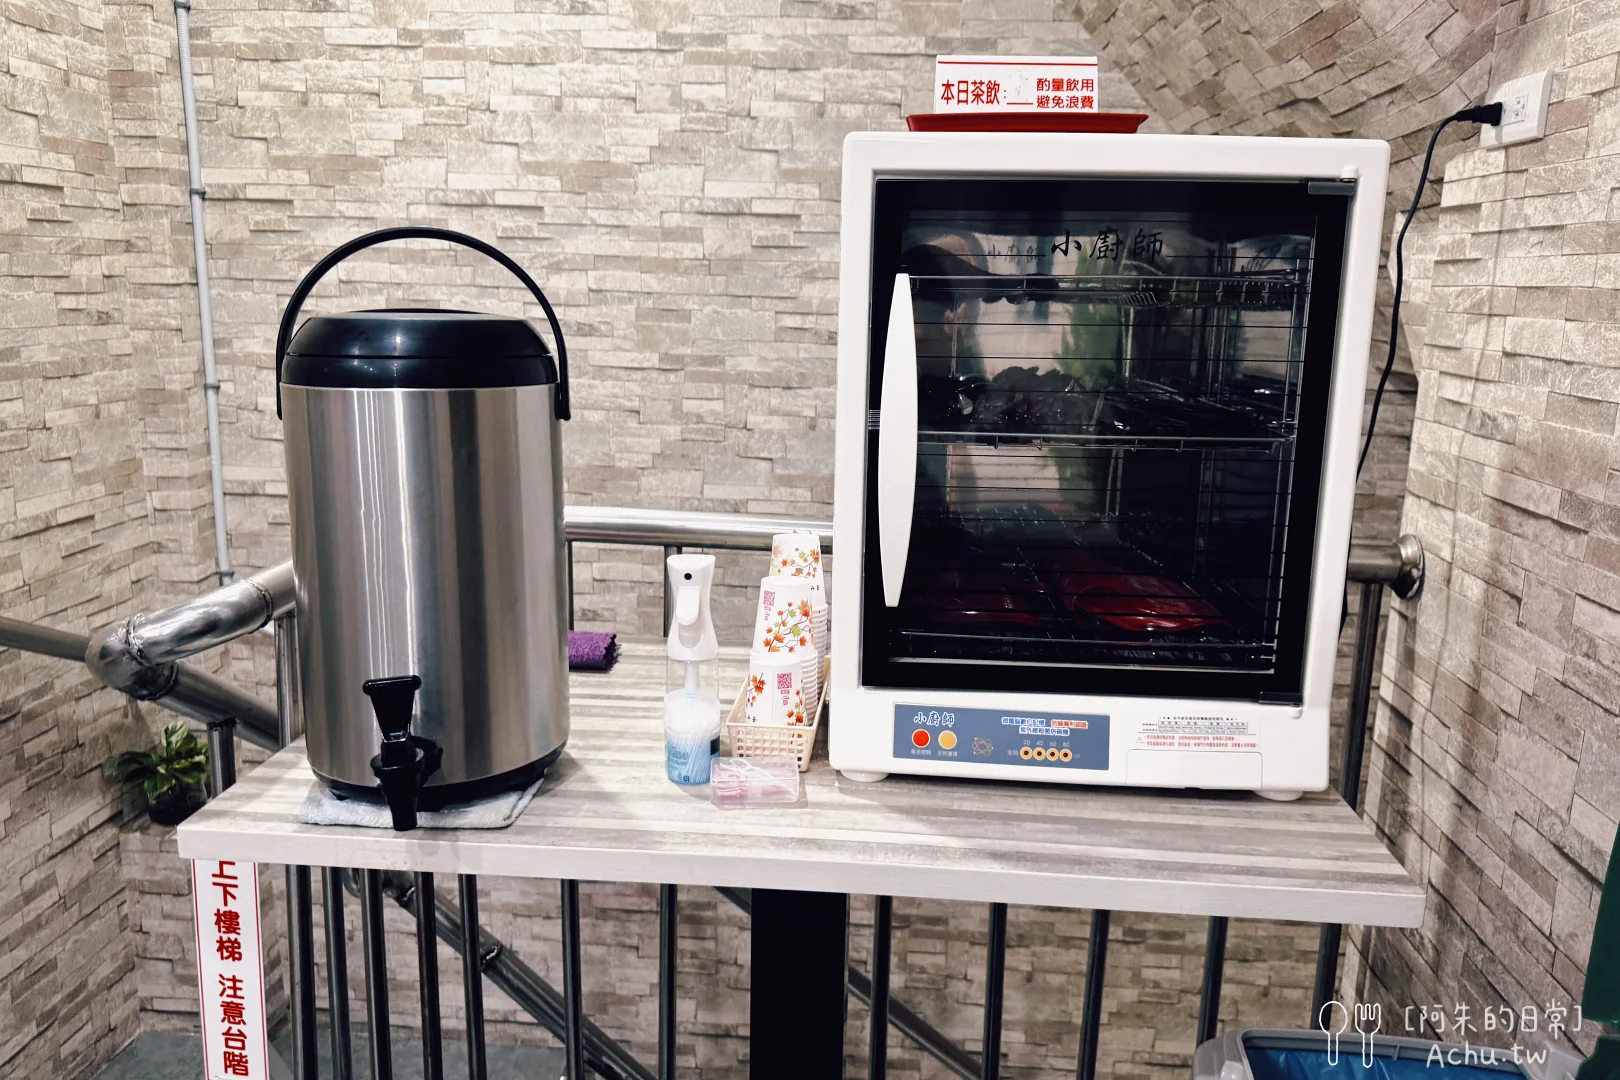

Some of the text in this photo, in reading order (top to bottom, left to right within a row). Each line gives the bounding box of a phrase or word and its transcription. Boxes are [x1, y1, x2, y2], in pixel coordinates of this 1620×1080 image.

[1036, 78, 1094, 92] 酌量飲用
[1036, 95, 1094, 109] 避免浪費
[218, 973, 250, 1077] 注意台階
